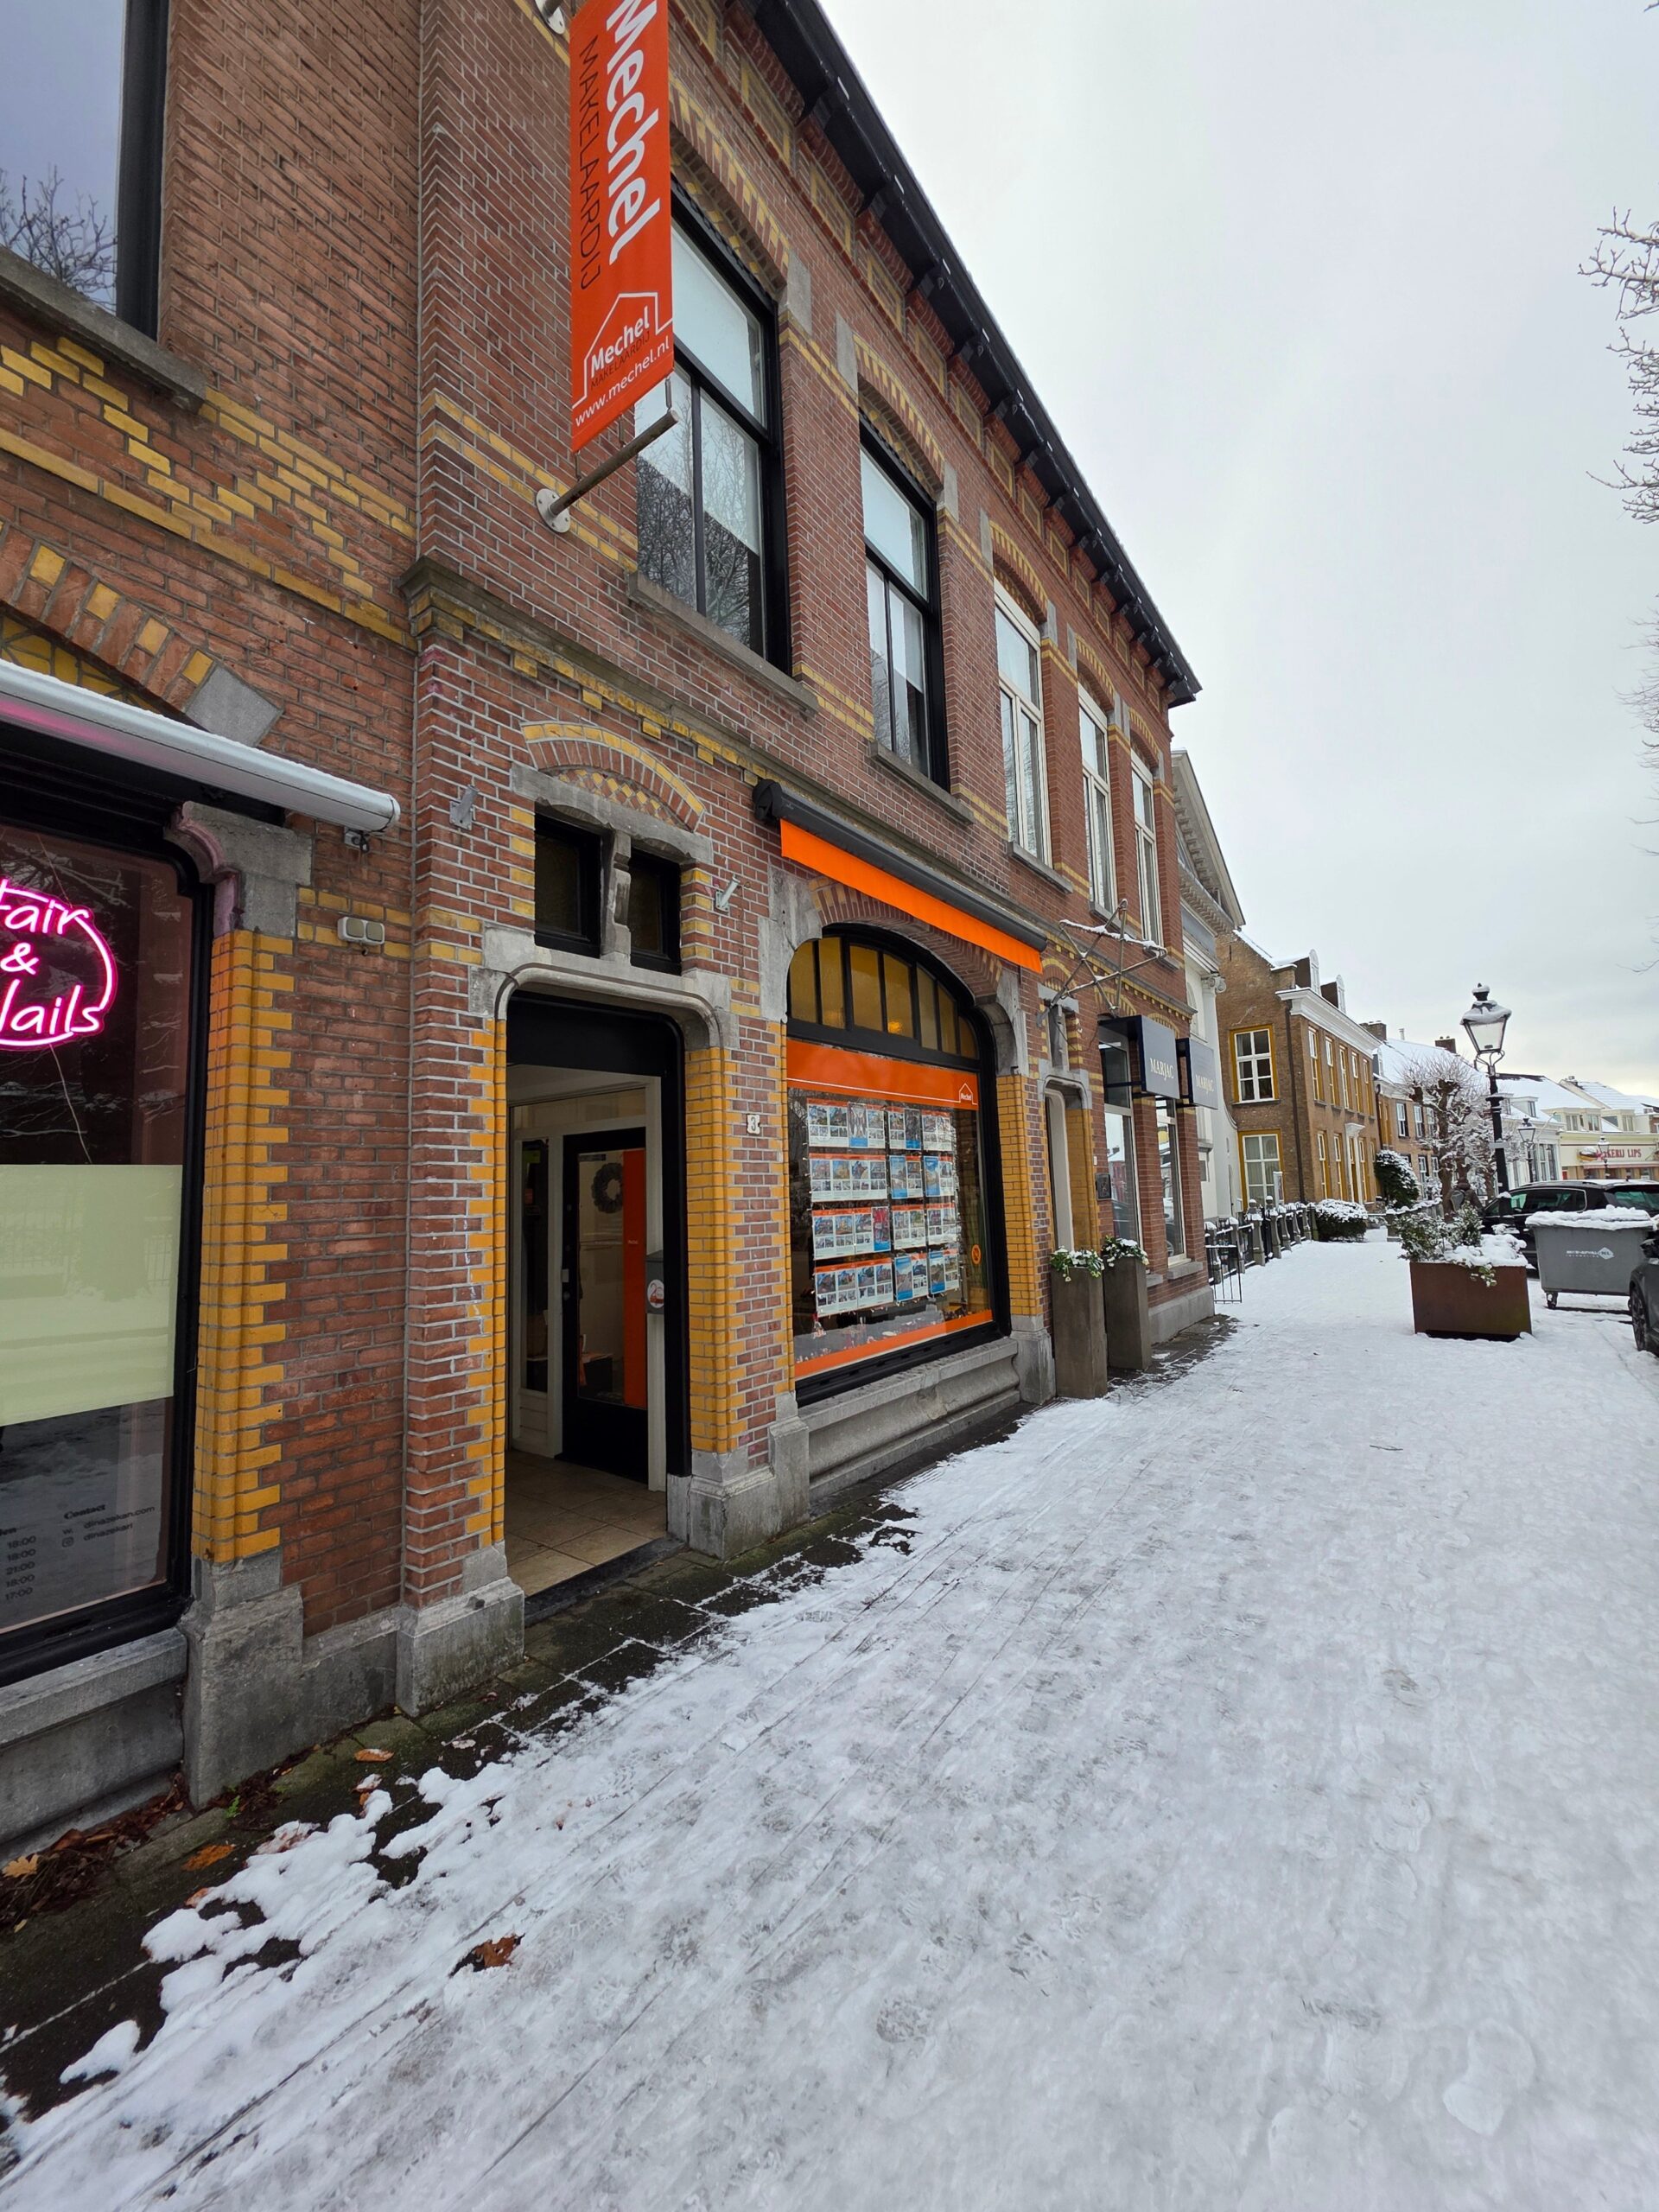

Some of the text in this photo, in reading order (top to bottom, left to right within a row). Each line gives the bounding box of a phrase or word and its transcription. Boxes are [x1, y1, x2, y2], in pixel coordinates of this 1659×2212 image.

[579, 34, 601, 290] MAKELAARDIJ
[607, 0, 660, 266] Mechel
[590, 305, 650, 378] Mechel
[590, 331, 651, 391] MAKELAARDIJ
[575, 335, 670, 427] www.mechel.nl
[0, 942, 39, 975] &
[1149, 1057, 1174, 1081] MARJAC
[1627, 1148, 1642, 1158] LIPS
